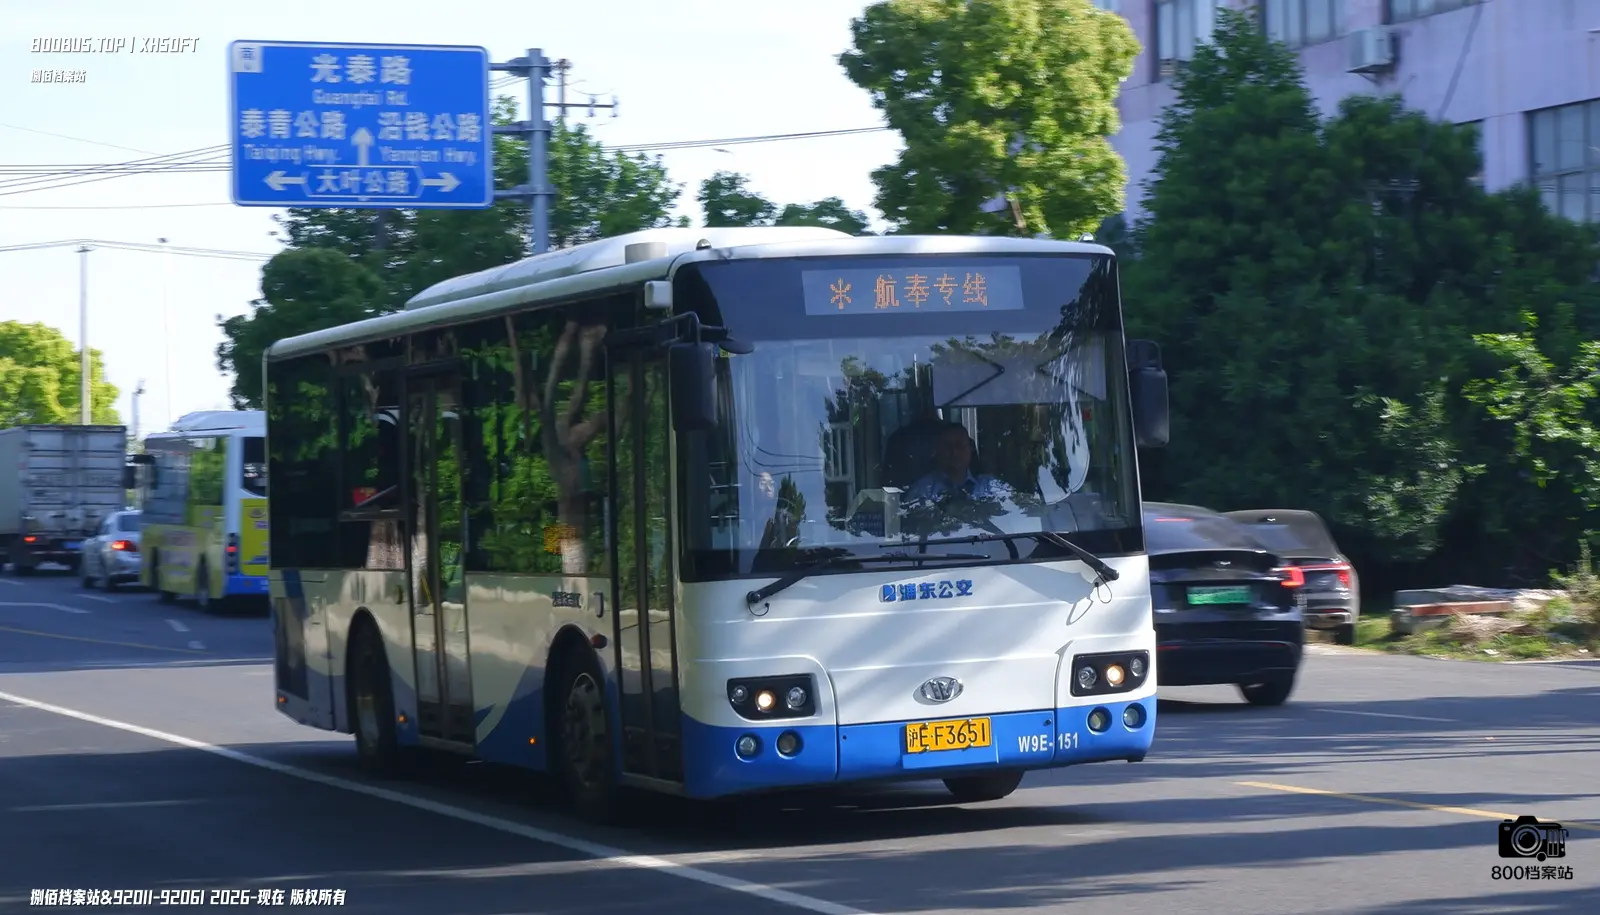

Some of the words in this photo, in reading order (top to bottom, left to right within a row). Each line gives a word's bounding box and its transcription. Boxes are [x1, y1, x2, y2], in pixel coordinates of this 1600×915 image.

[309, 53, 413, 85] 光泰路
[239, 108, 348, 140] 泰青公路
[315, 167, 410, 195] 大叶公路
[873, 272, 989, 309] 航奉专线
[899, 578, 973, 602] 浦东公交
